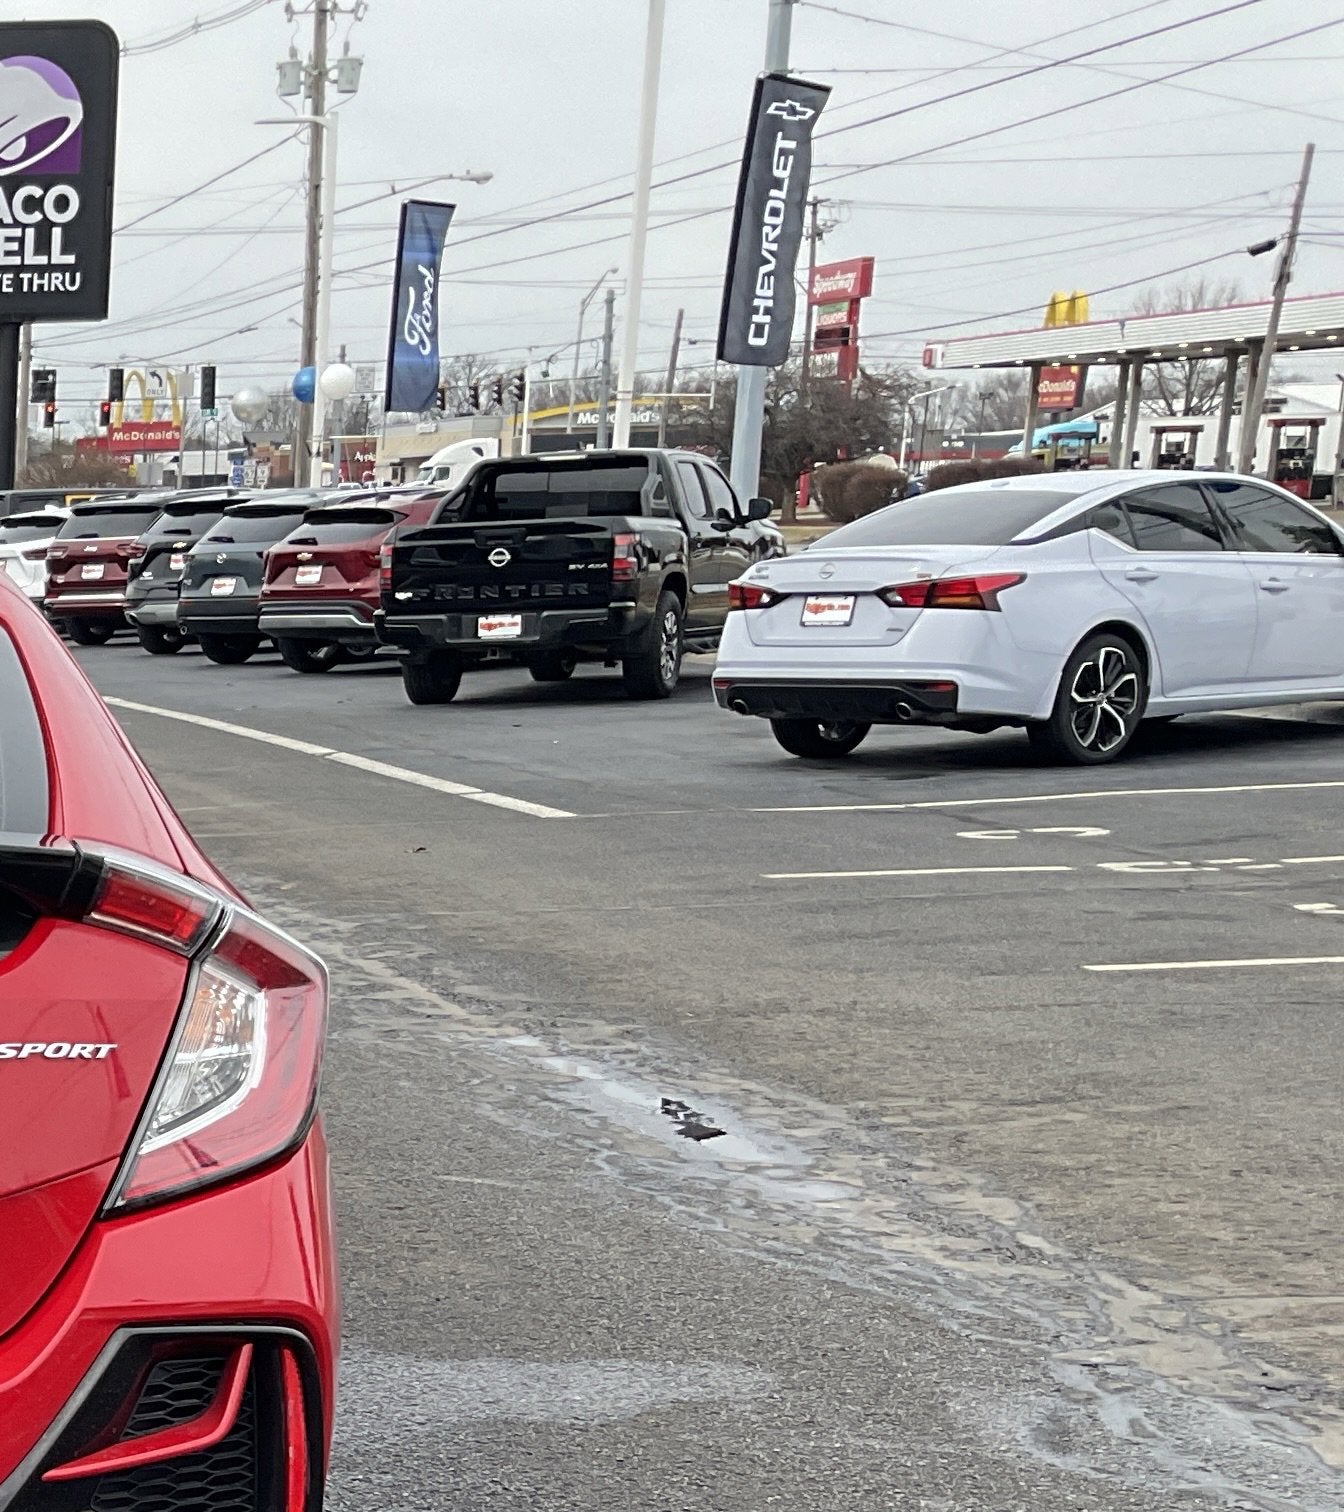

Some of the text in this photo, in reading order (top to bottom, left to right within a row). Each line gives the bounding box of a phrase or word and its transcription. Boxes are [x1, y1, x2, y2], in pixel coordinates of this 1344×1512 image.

[747, 131, 798, 347] CHEVROLET
[19, 272, 81, 294] THRU
[813, 269, 857, 299] Speedway
[404, 264, 435, 356] Ford
[1038, 379, 1076, 393] cDonald's
[413, 582, 589, 601] FRONTIER
